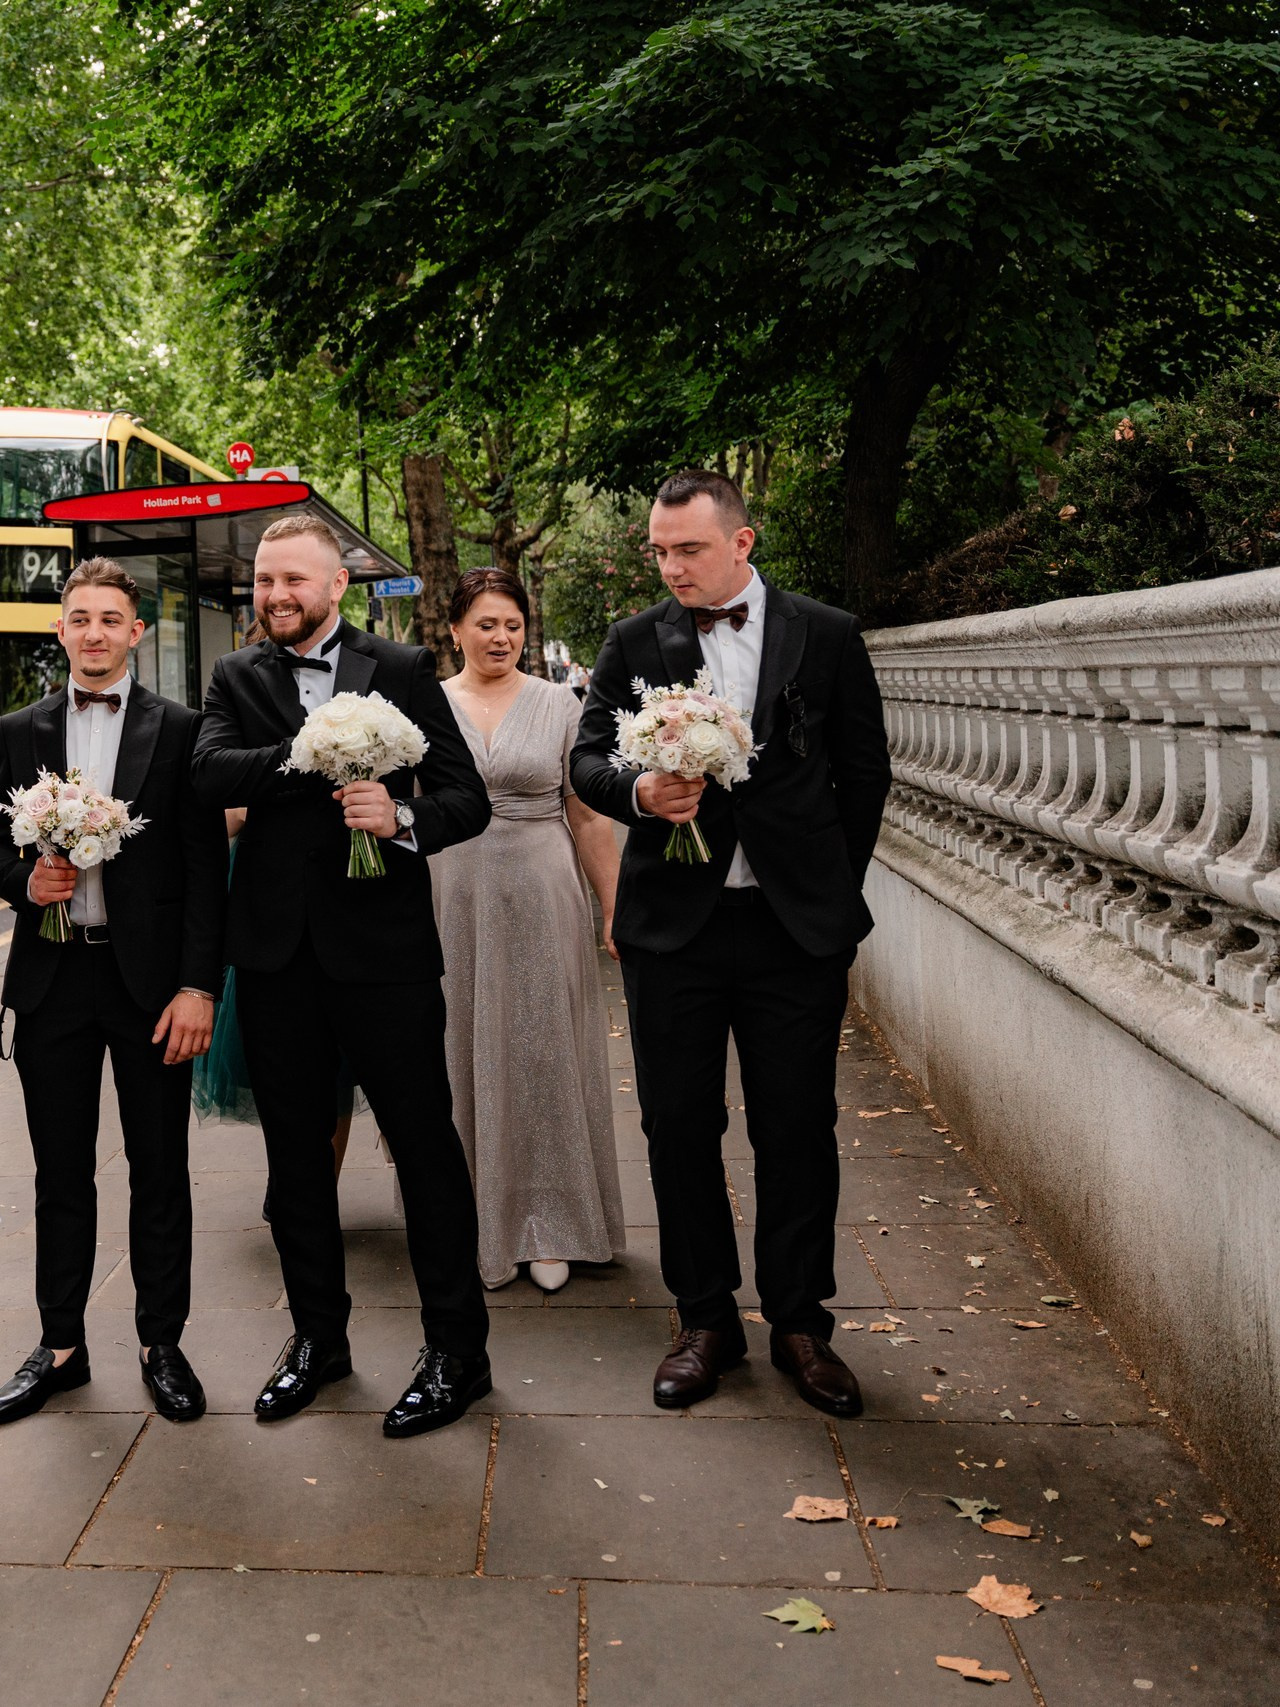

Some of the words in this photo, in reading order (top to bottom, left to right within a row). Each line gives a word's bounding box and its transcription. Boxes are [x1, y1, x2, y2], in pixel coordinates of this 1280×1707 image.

[230, 450, 251, 463] HA
[143, 496, 179, 508] Holland
[181, 495, 202, 505] Park
[23, 551, 61, 583] 94
